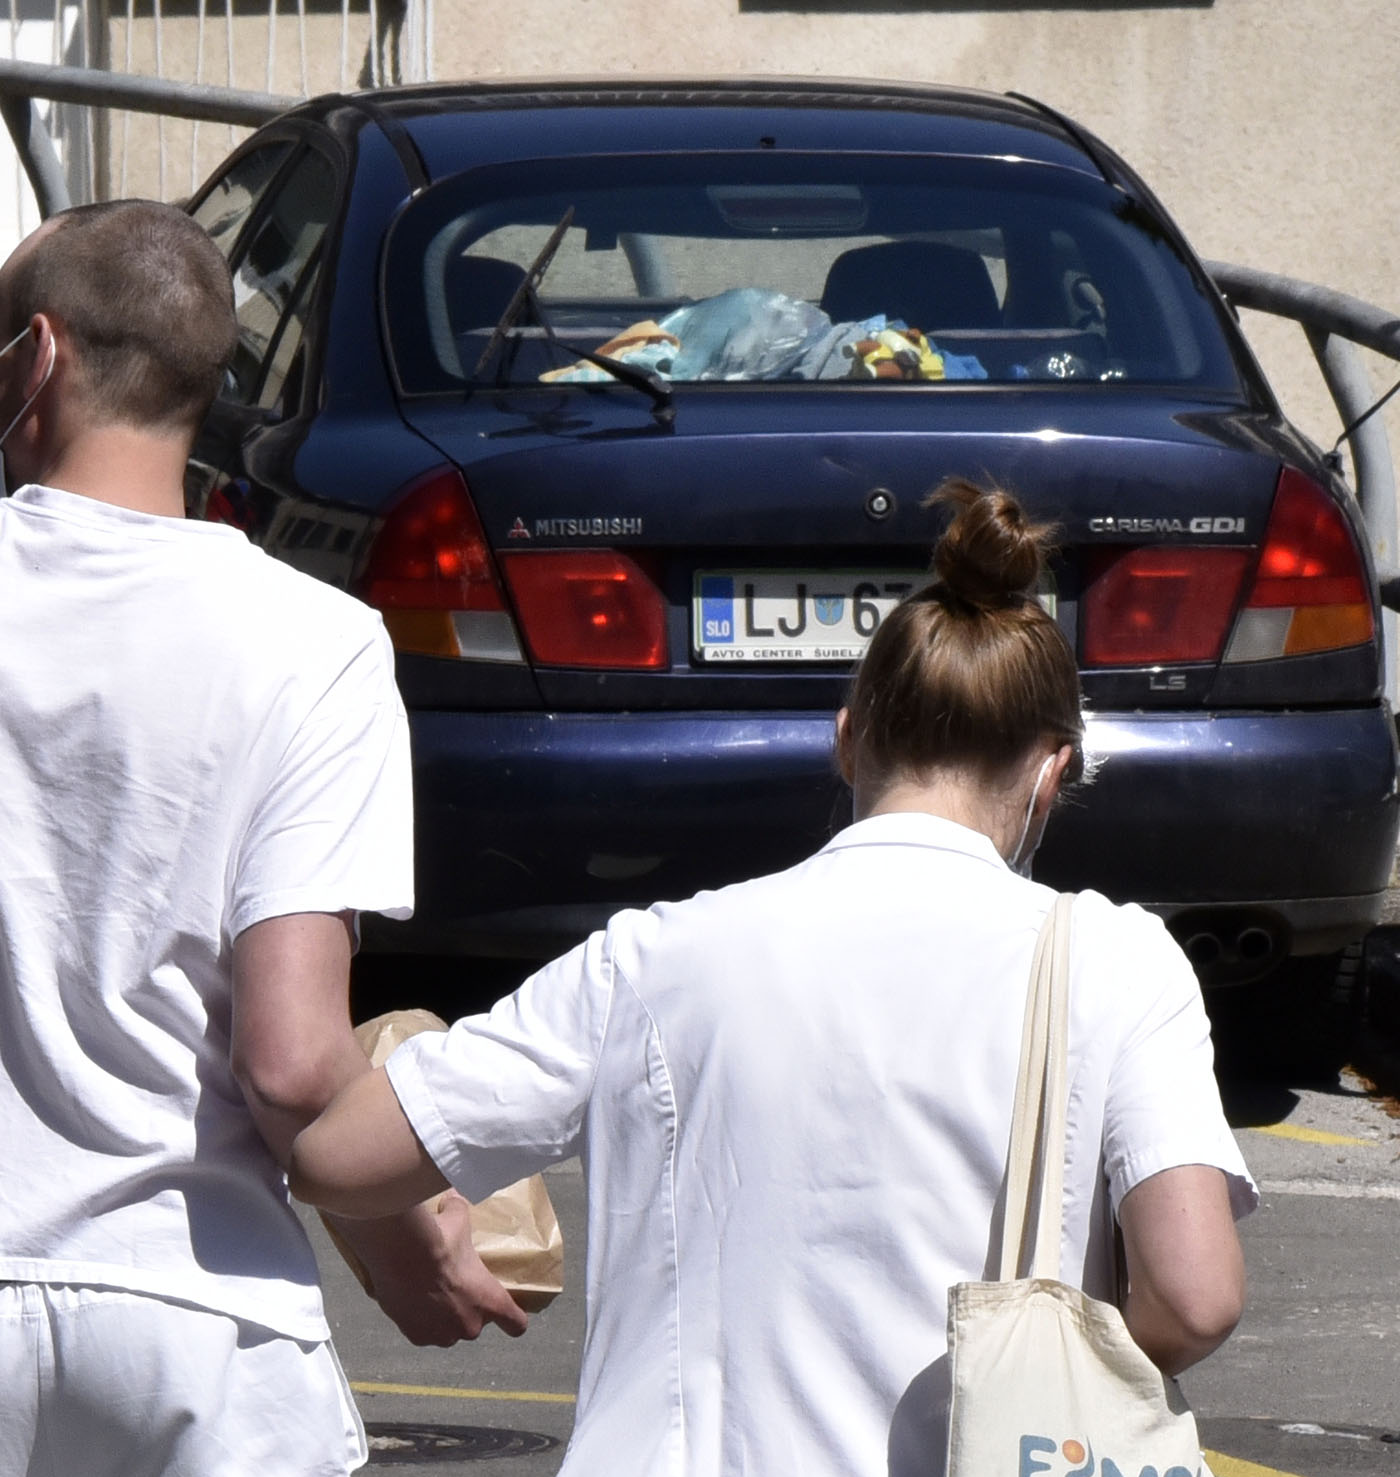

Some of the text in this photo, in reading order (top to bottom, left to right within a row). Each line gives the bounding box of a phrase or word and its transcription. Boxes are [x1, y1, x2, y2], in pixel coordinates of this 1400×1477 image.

[535, 517, 642, 536] MITSUBISHI
[1088, 516, 1245, 533] CARISMA GDI
[745, 583, 807, 638] LJ
[705, 619, 731, 638] SLO
[712, 649, 744, 659] AVTO
[753, 649, 803, 659] CENTER
